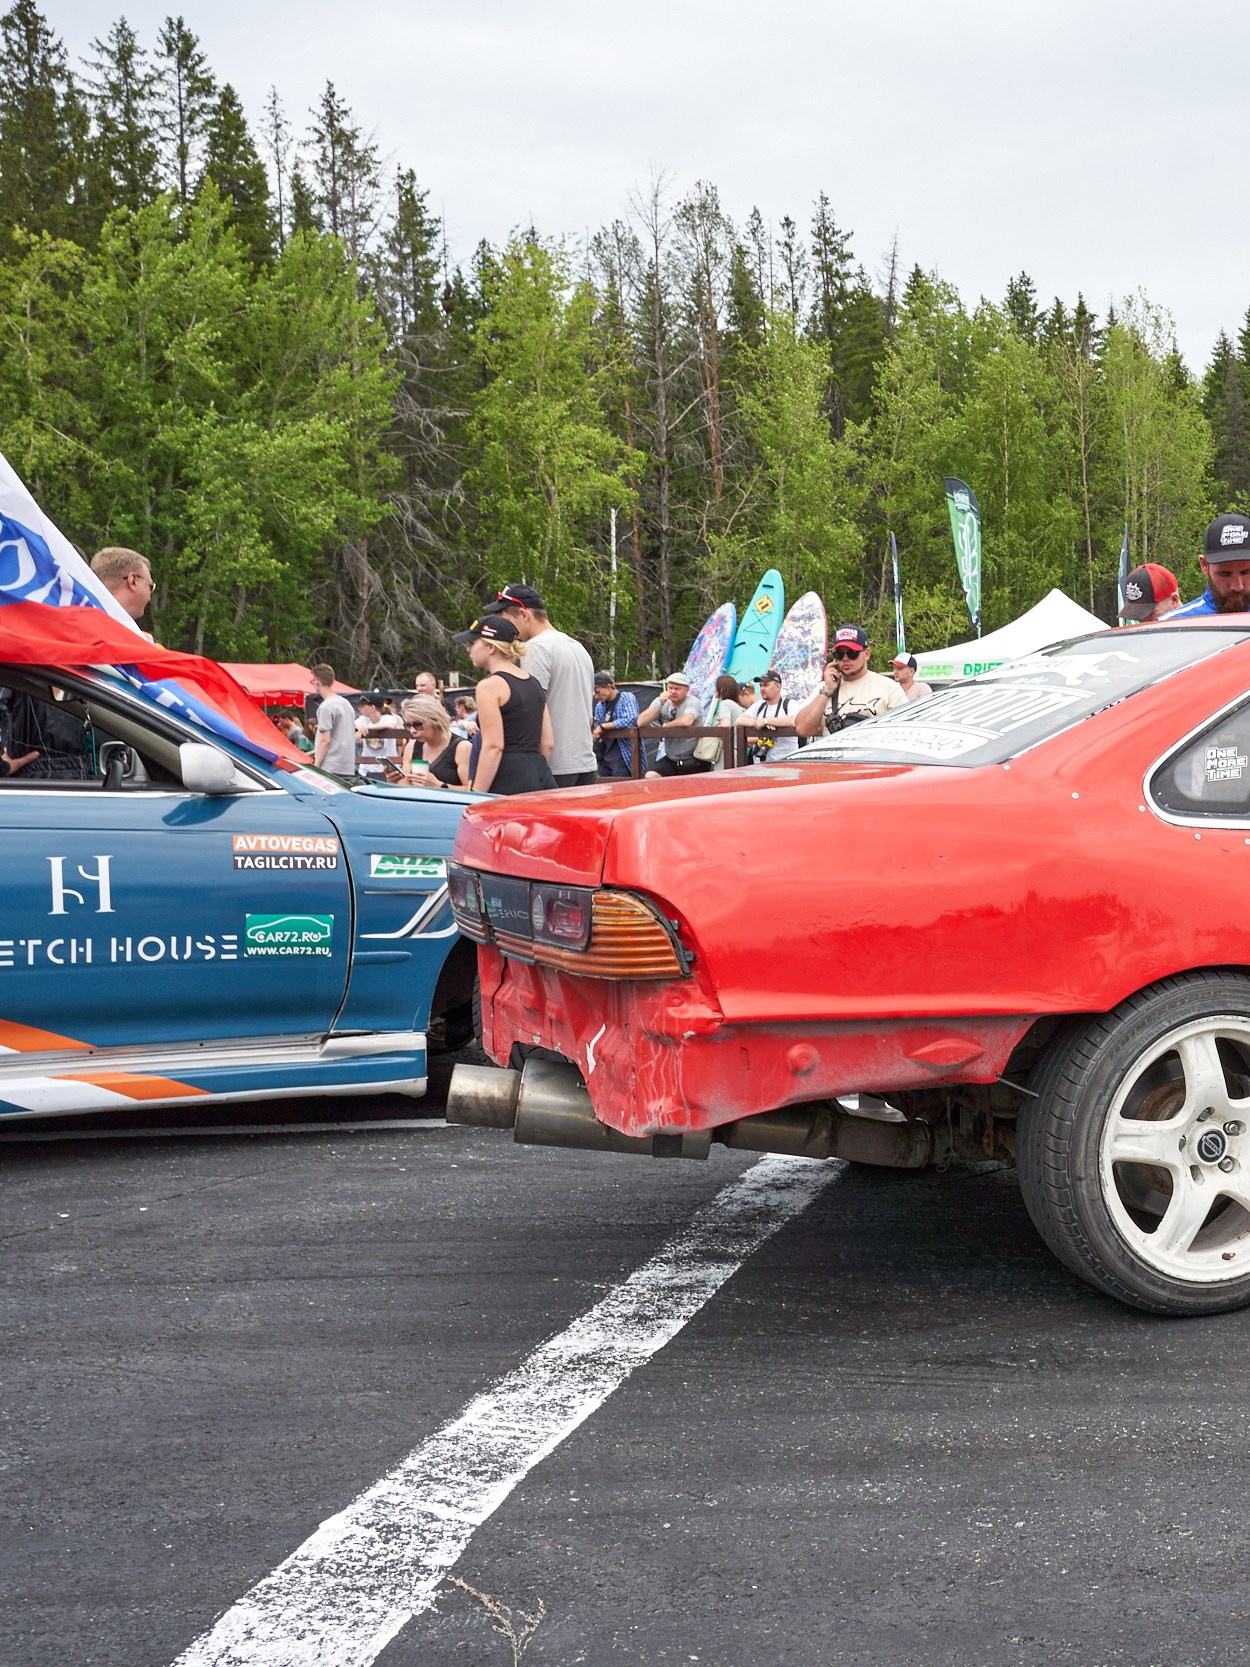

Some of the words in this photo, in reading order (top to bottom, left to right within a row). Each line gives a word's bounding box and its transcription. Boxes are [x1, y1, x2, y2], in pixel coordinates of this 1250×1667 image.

[1206, 748, 1236, 759] ONE
[1206, 757, 1246, 770] MORE
[1207, 768, 1240, 780] TIME
[235, 836, 337, 852] AVTOVEGAS
[234, 856, 337, 870] TAGILCITY.RU
[374, 855, 444, 876] DWC
[255, 931, 322, 943] CAR72.RU
[111, 935, 238, 963] HOUSE
[247, 947, 329, 955] WWW.CAR72.RU
